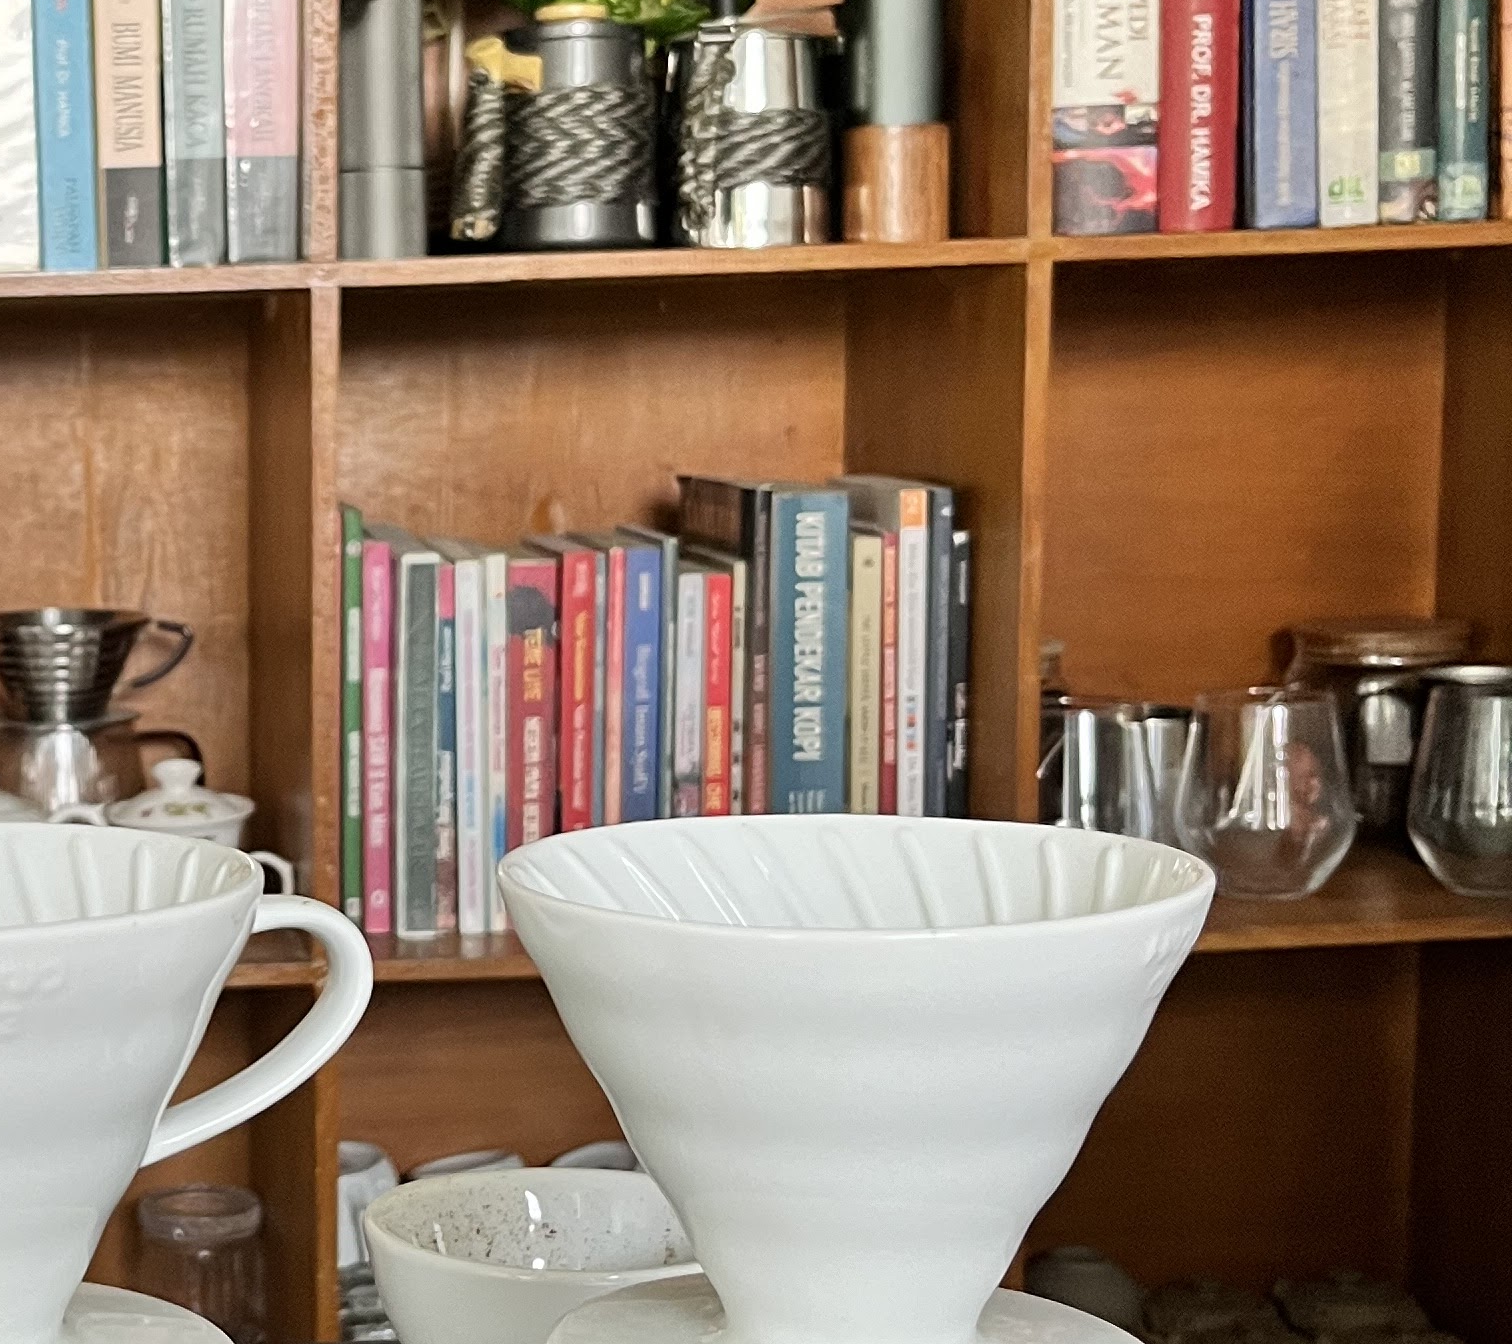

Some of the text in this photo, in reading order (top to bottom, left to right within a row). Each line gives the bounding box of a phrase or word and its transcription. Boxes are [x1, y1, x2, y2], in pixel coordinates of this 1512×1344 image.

[111, 21, 144, 153] BUMI MANUSIA
[184, 88, 209, 149] KACA
[791, 511, 826, 762] KITAB PENDEKAR KOPI
